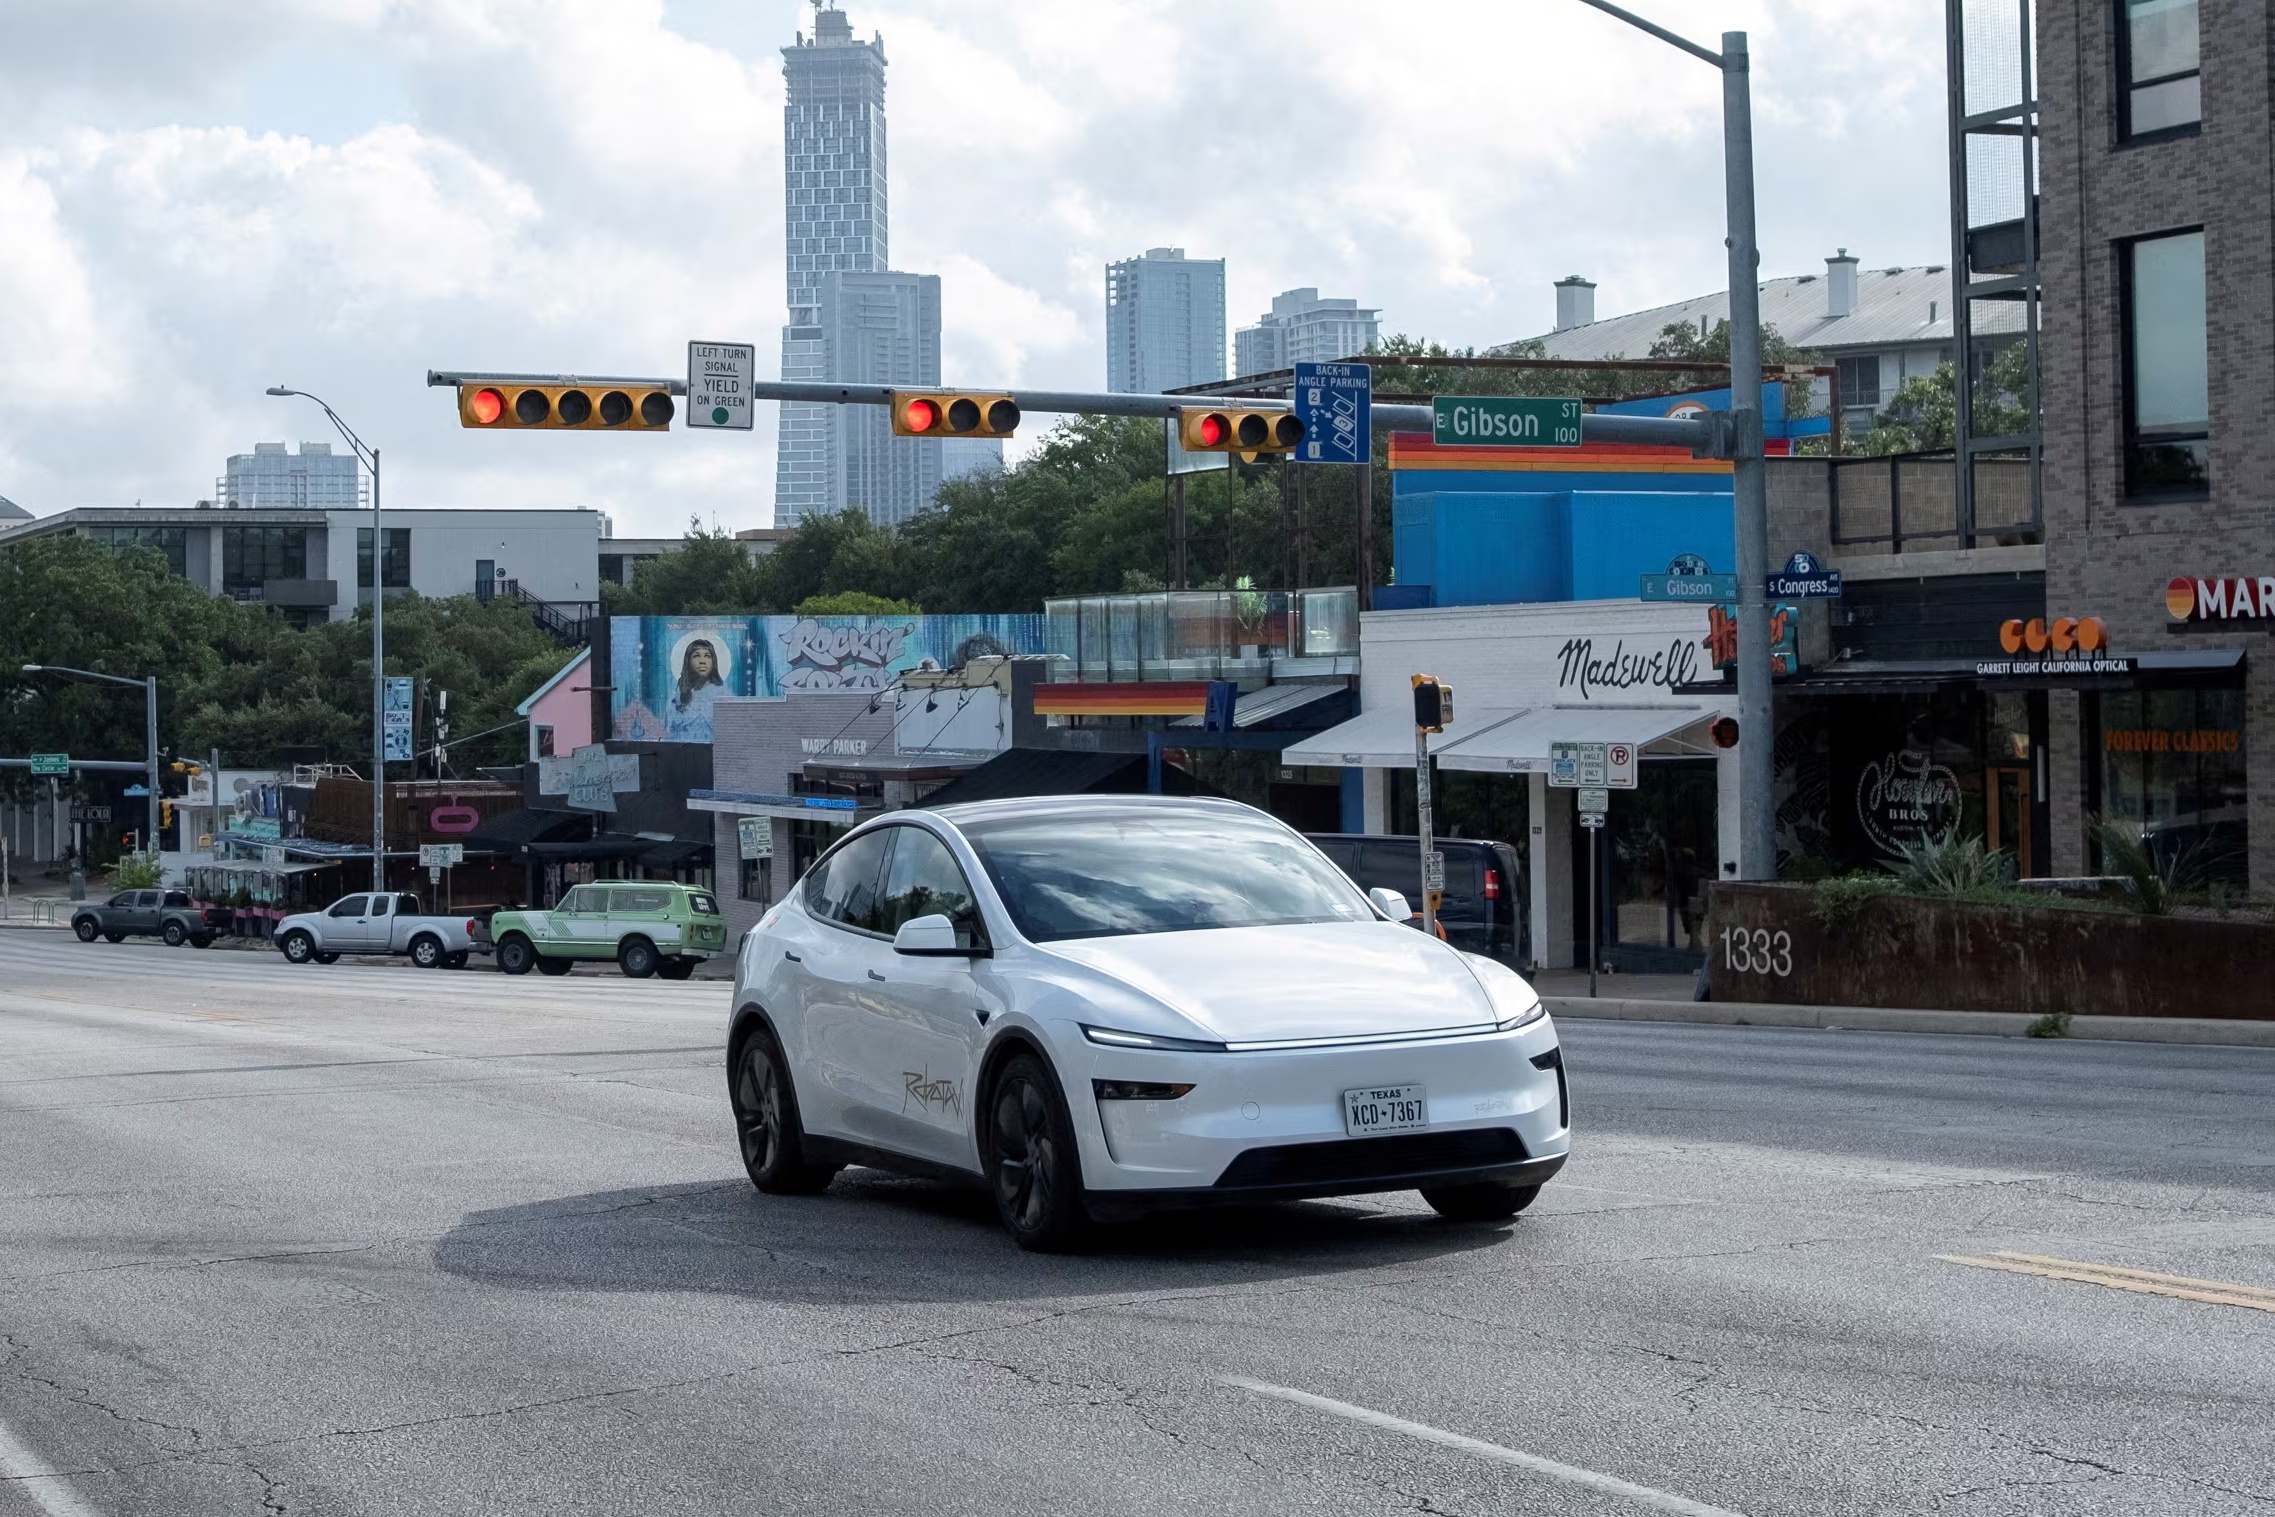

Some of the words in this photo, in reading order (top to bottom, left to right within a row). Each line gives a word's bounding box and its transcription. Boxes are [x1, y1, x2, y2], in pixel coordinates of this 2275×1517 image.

[697, 347, 718, 357] LEFT
[723, 348, 747, 359] TURN
[705, 361, 738, 372] SIGNAL
[1316, 365, 1350, 376] BACK-IN
[704, 379, 739, 393] YIELD
[1299, 376, 1326, 387] ANGLE
[1330, 377, 1367, 388] PARKING
[697, 395, 710, 405] ON
[715, 396, 745, 407] GREEN
[1436, 413, 1446, 429] E
[1453, 406, 1539, 437] Gibson
[1561, 403, 1578, 418] ST
[1555, 427, 1578, 443] 100
[1647, 583, 1653, 592] E
[1667, 580, 1713, 596] Gibson
[1769, 582, 1775, 592] S
[1778, 579, 1828, 597] Congress
[1557, 638, 1698, 700] Madewell
[1976, 662, 2011, 674] GARRETT
[2013, 662, 2040, 674] LEIGHT
[2041, 661, 2091, 673] CALIFORNIA
[2093, 660, 2129, 672] OPTICAL
[801, 738, 831, 755] WARBY
[833, 738, 867, 756] PARKER
[2106, 731, 2169, 751] FOREVER
[2173, 731, 2239, 751] CLASSICS
[574, 787, 609, 802] CLUB
[1889, 808, 1929, 822] BROS
[1720, 926, 1792, 977] 1333
[1370, 1089, 1401, 1100] TEXAS
